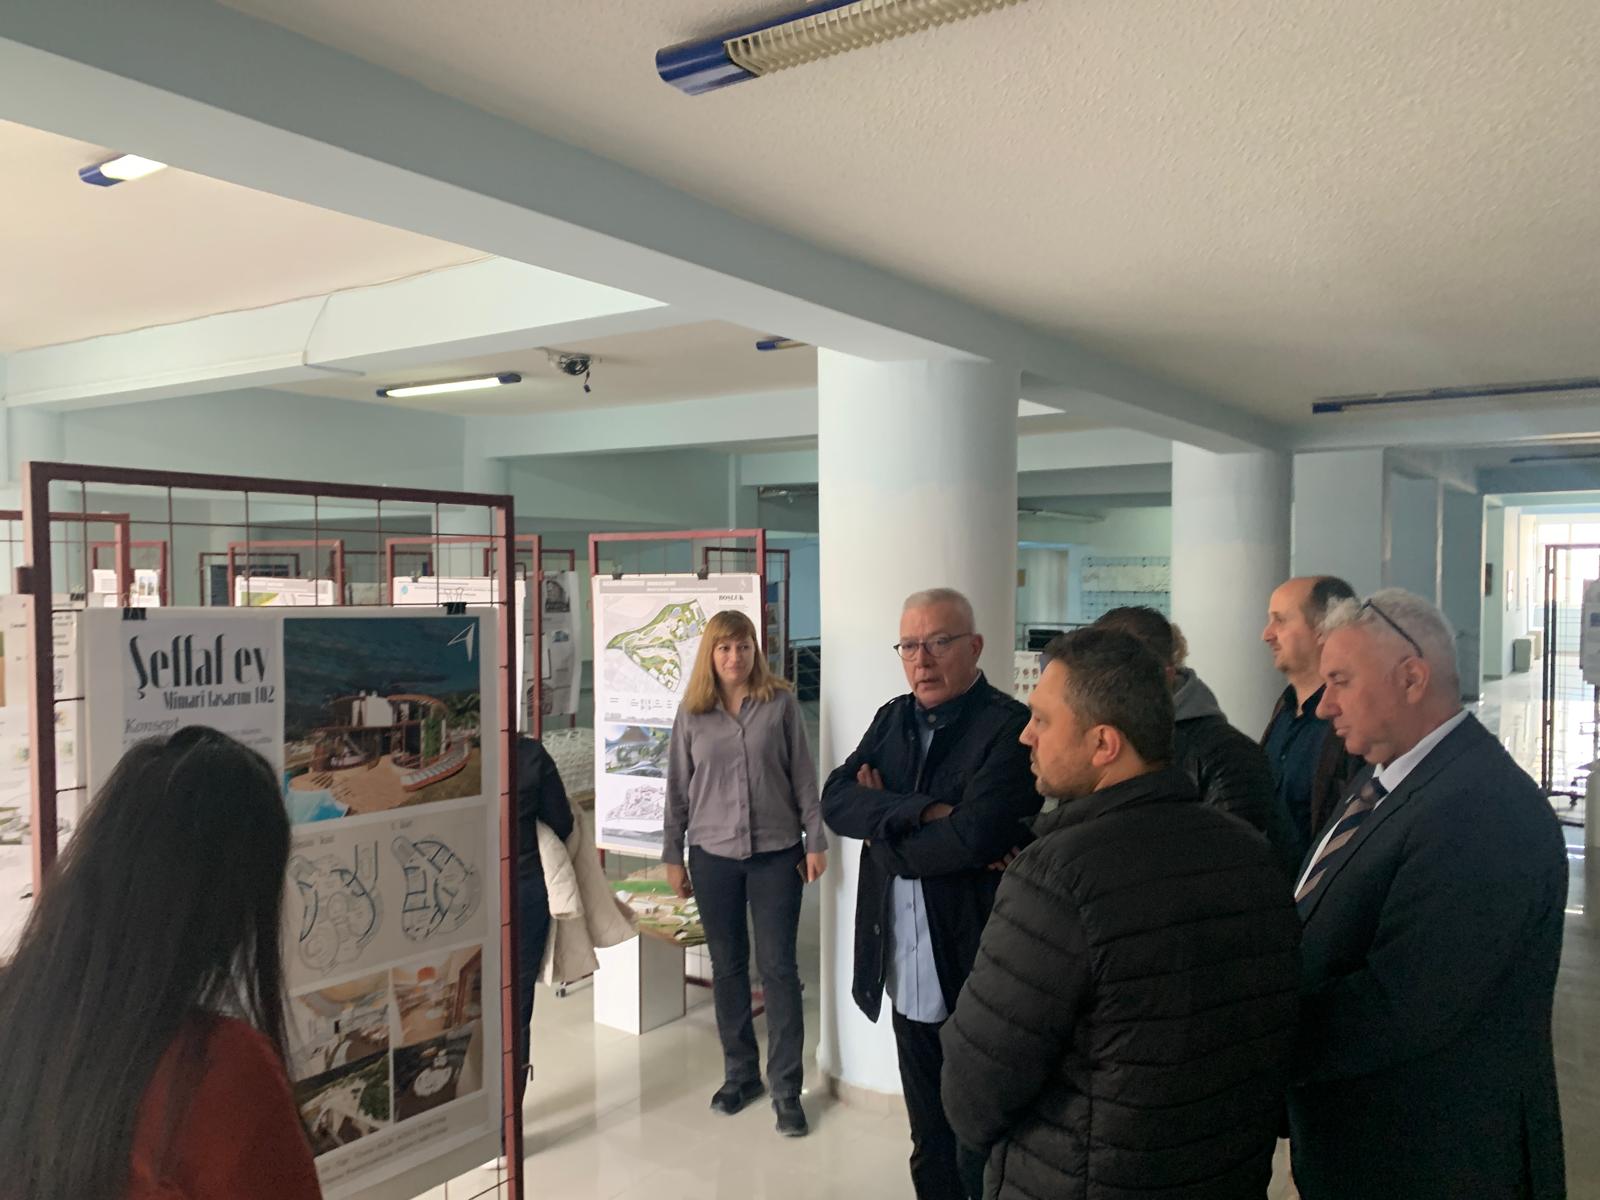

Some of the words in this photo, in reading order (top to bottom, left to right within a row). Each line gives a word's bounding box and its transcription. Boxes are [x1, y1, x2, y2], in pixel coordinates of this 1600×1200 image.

[129, 633, 225, 700] Şeffaf
[234, 647, 269, 685] ev
[255, 686, 275, 704] 102
[123, 716, 180, 737] Konsept
